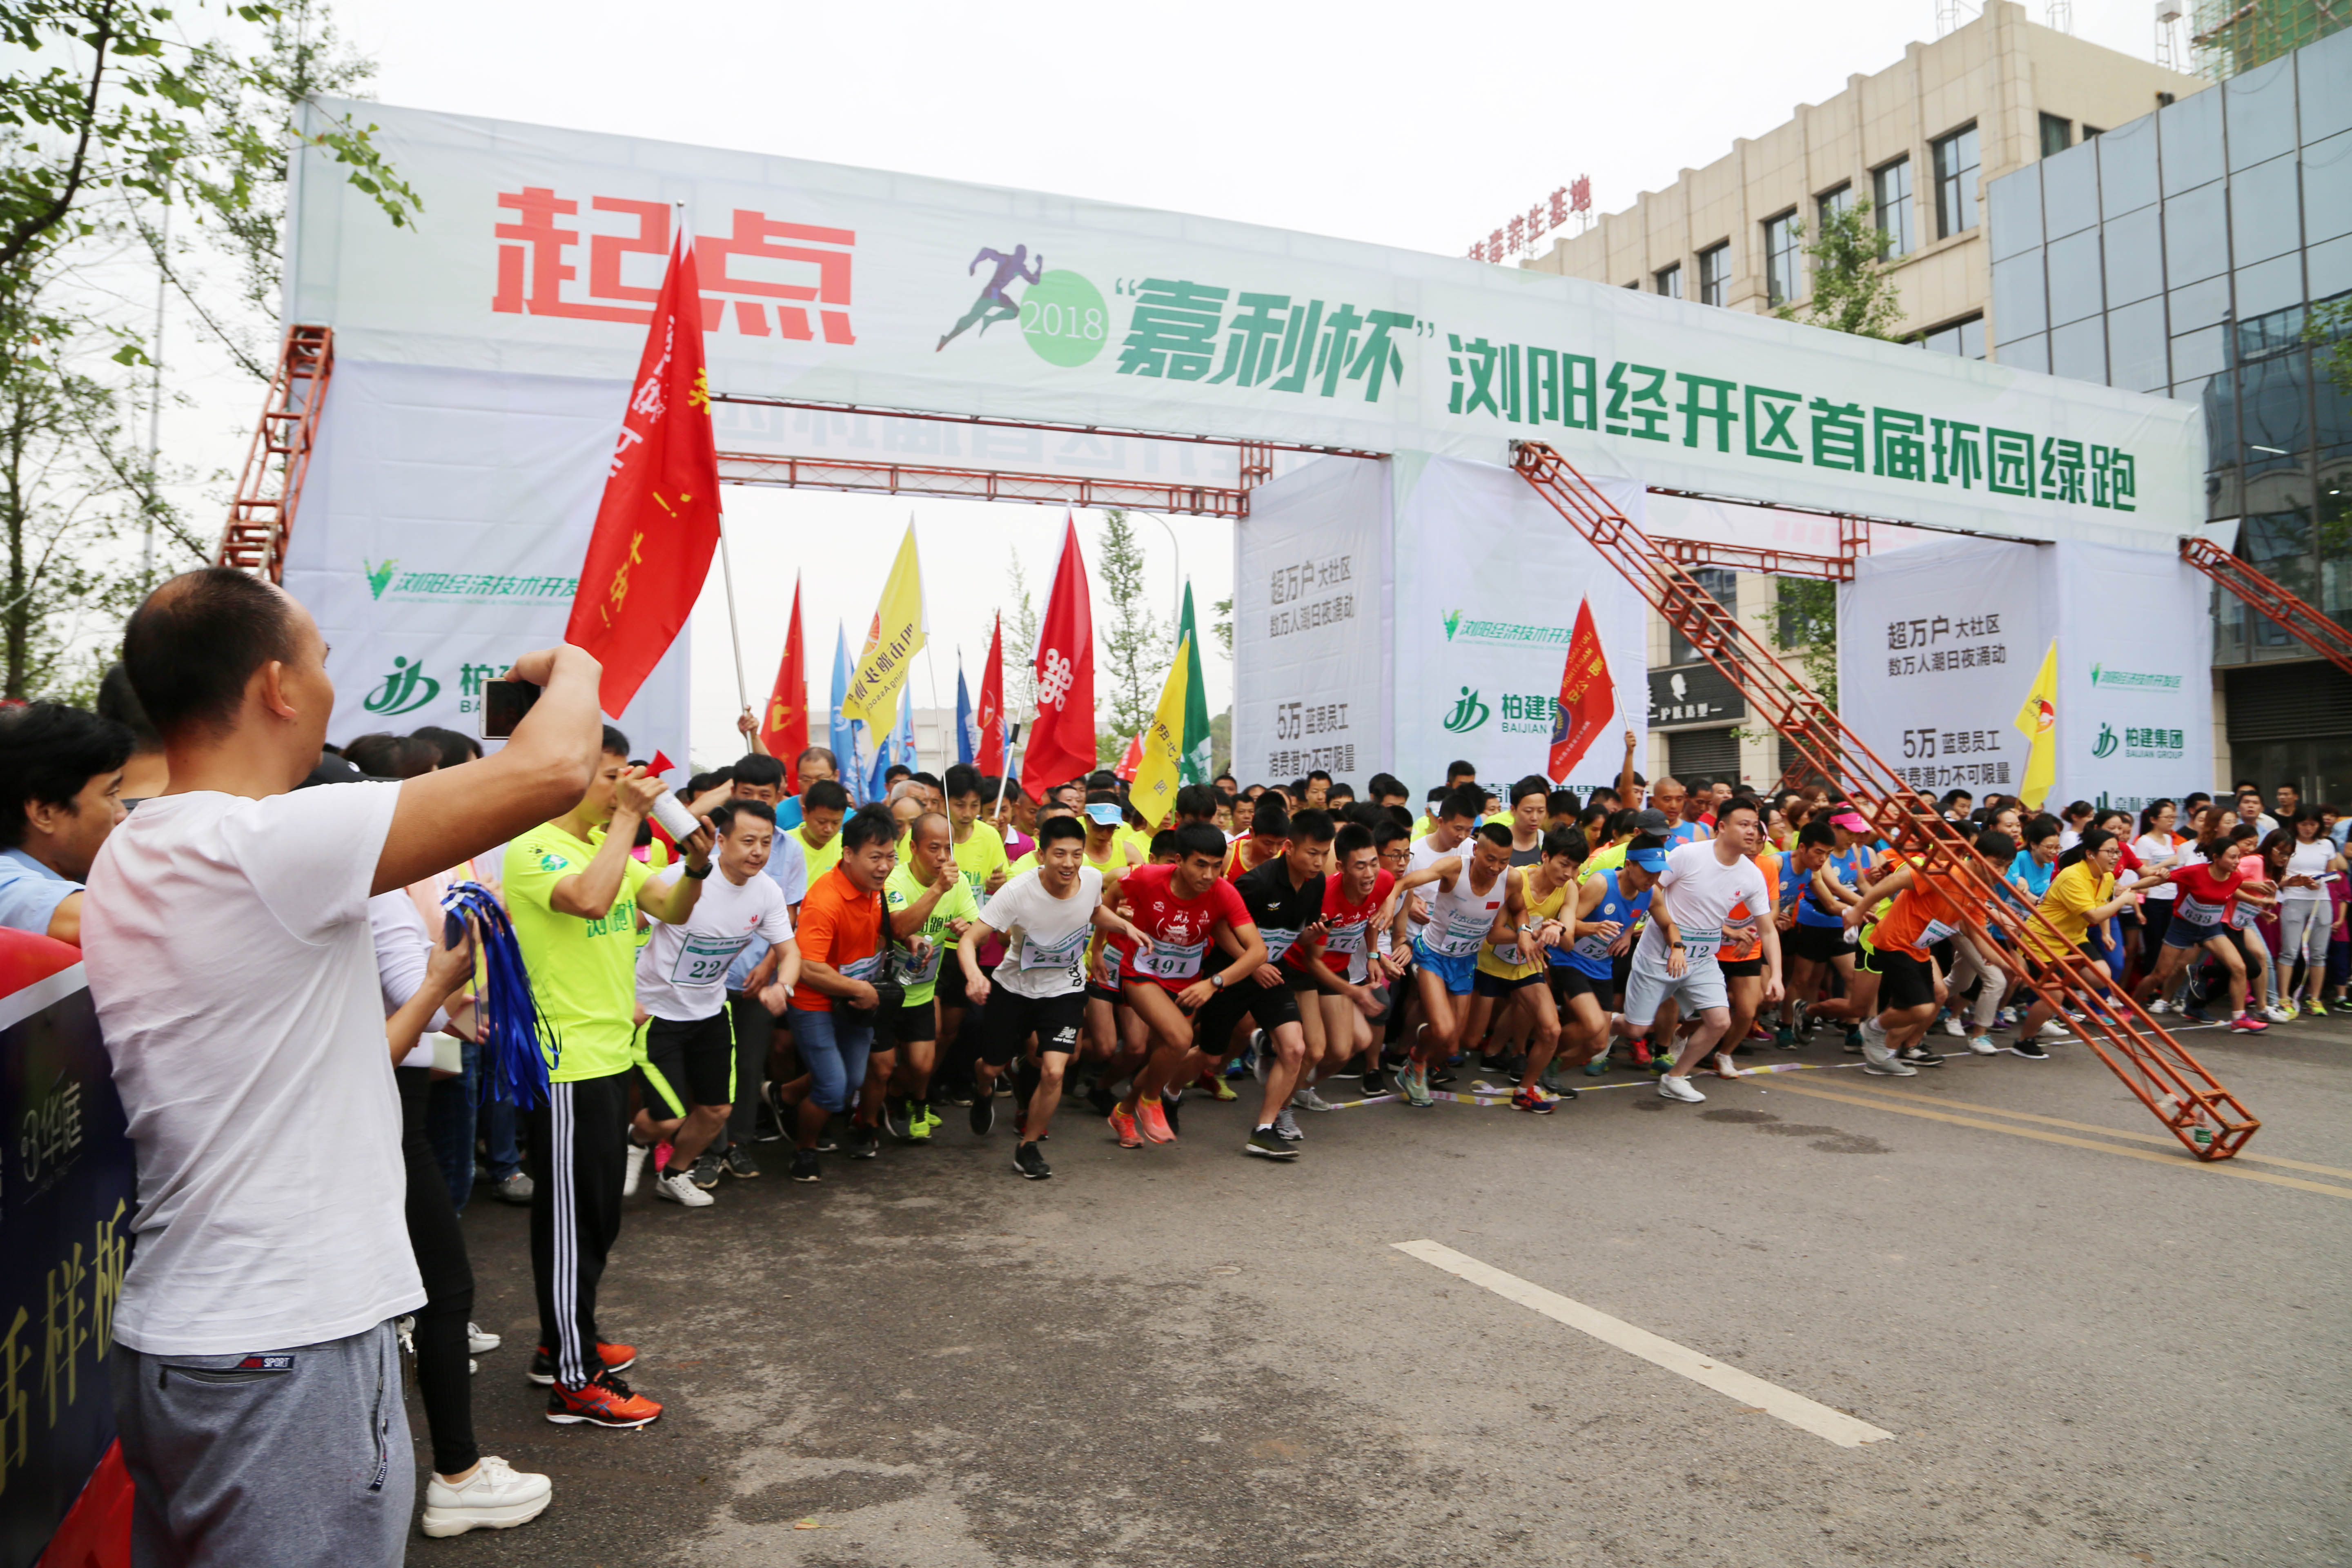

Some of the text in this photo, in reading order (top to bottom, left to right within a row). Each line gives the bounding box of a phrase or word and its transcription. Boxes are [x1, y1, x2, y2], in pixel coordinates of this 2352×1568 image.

[492, 186, 856, 345] 起点
[1021, 300, 1103, 342] 2018
[1448, 333, 2136, 513] 浏阳经开区首届环园绿跑
[1887, 614, 2001, 650] 超万户 大社区
[1887, 644, 2006, 677] 数万人潮日夜涌动
[1502, 722, 1547, 734] BAIJIAN
[2125, 727, 2184, 749] 柏建集团
[1903, 728, 2001, 759] 5万 蓝思员工
[2126, 749, 2184, 759] BAIJIAN GROUP
[1326, 936, 1363, 950] 475
[1446, 940, 1481, 953] 476
[1147, 958, 1188, 974] 491
[263, 1357, 290, 1368] SPORT
